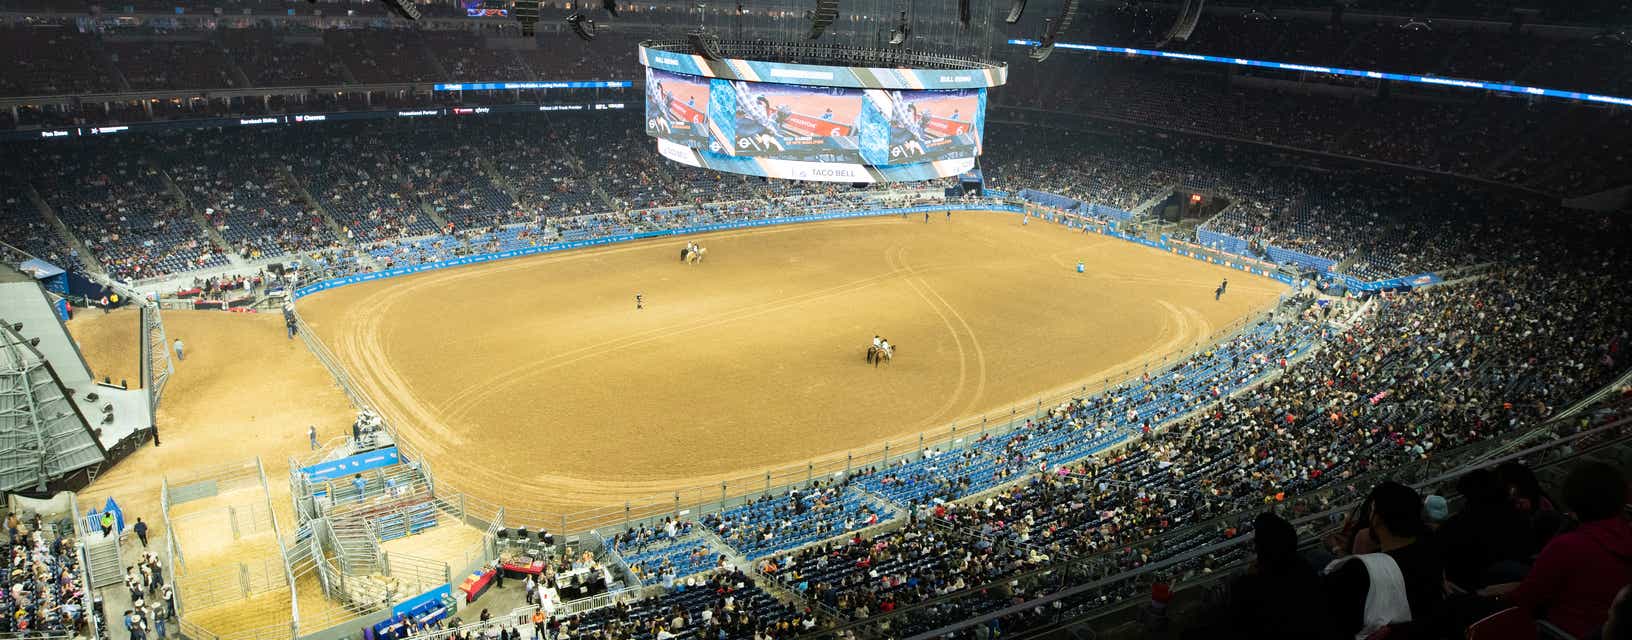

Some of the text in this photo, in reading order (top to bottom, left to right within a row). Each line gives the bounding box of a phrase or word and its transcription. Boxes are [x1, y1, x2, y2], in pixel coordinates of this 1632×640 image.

[940, 75, 953, 83] BULL
[693, 114, 699, 124] 6
[830, 127, 841, 137] 6
[956, 126, 963, 136] 6
[812, 168, 856, 178] TACO BELL
